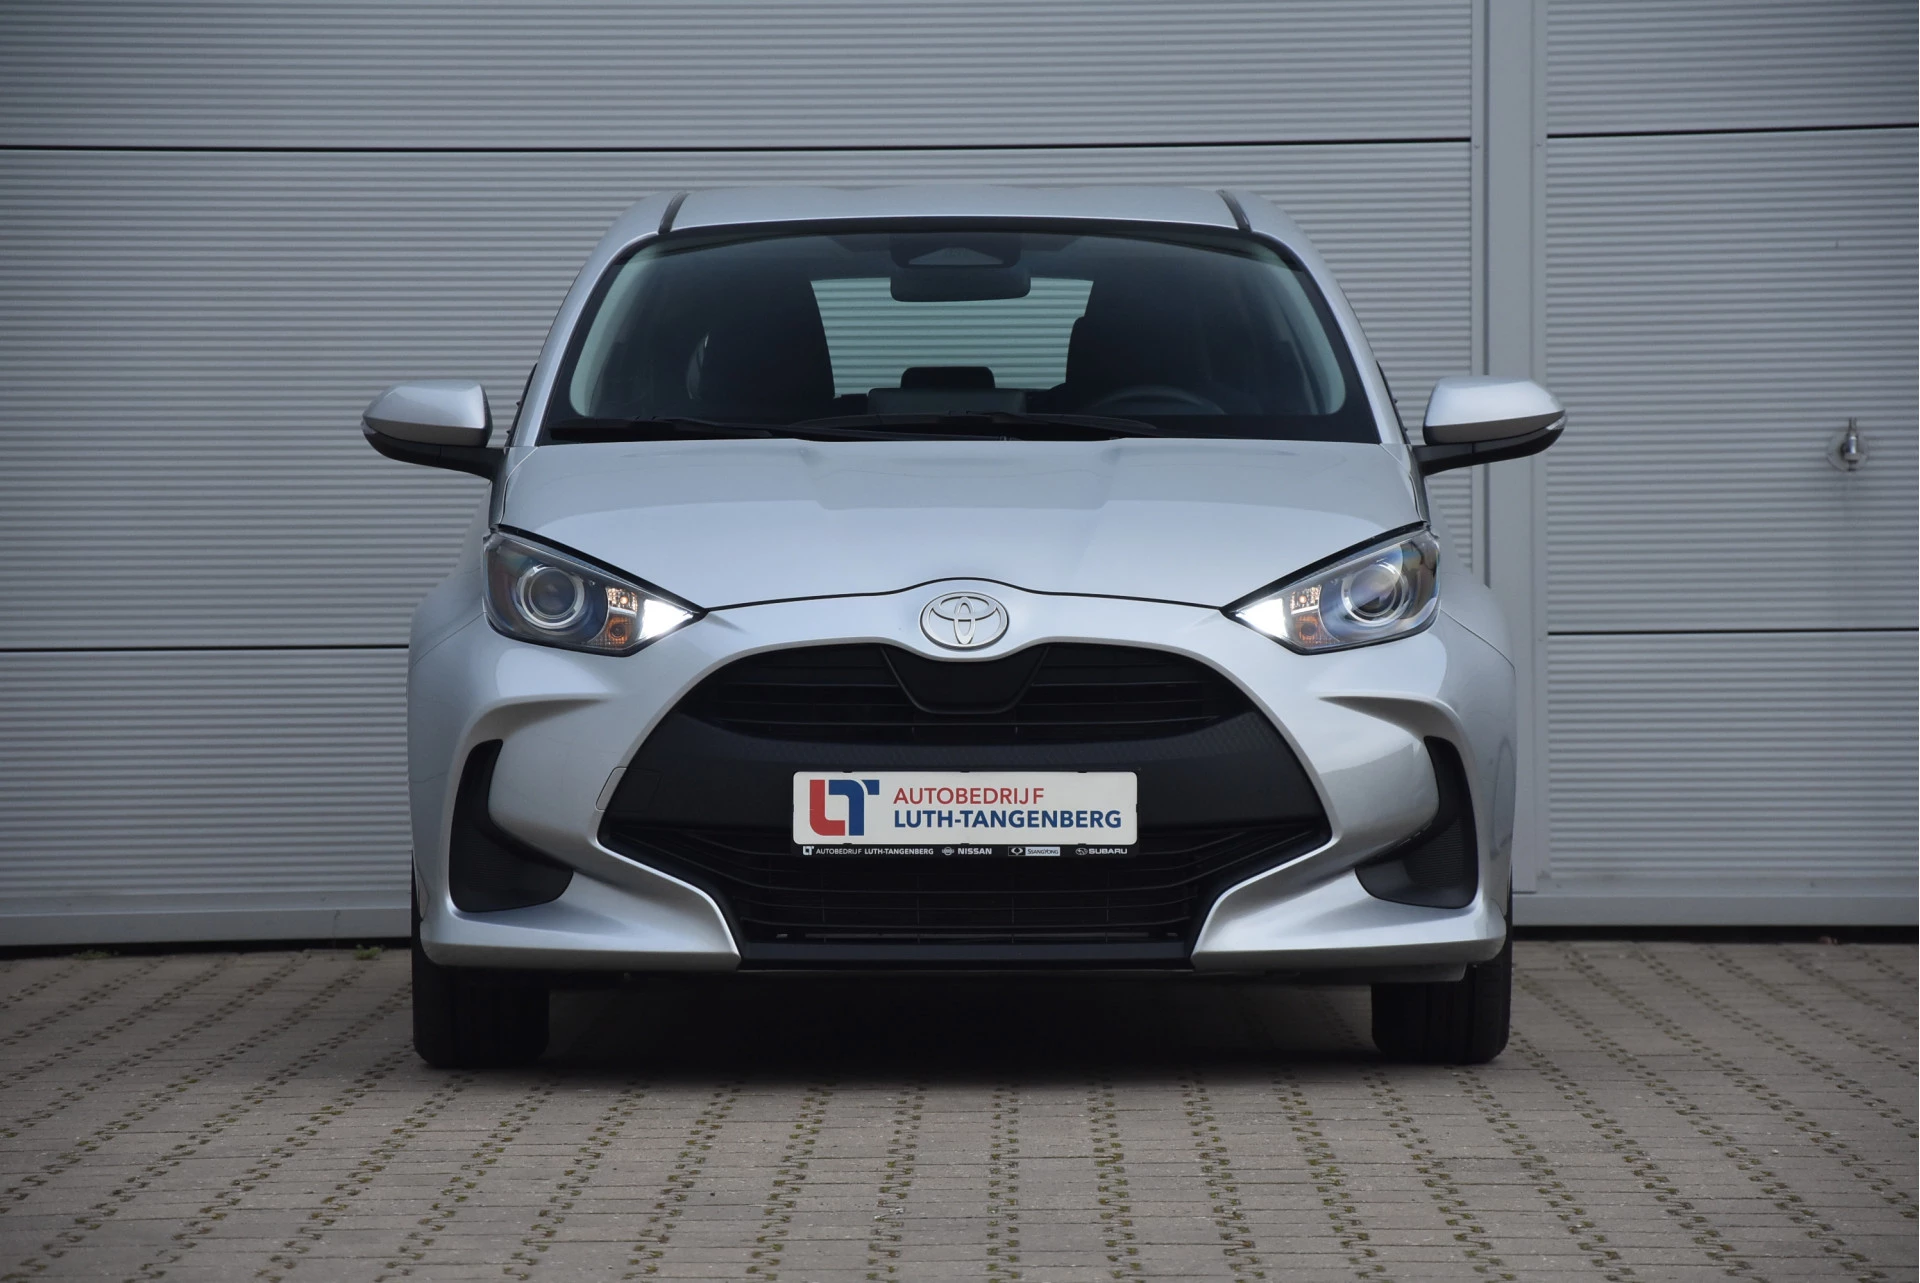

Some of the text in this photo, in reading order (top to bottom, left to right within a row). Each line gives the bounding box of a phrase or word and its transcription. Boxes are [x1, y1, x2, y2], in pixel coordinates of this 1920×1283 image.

[893, 787, 1044, 805] AUTOBEDRIJF
[894, 810, 1122, 829] LUTH-TANGENBERG
[957, 847, 992, 855] NISSAN
